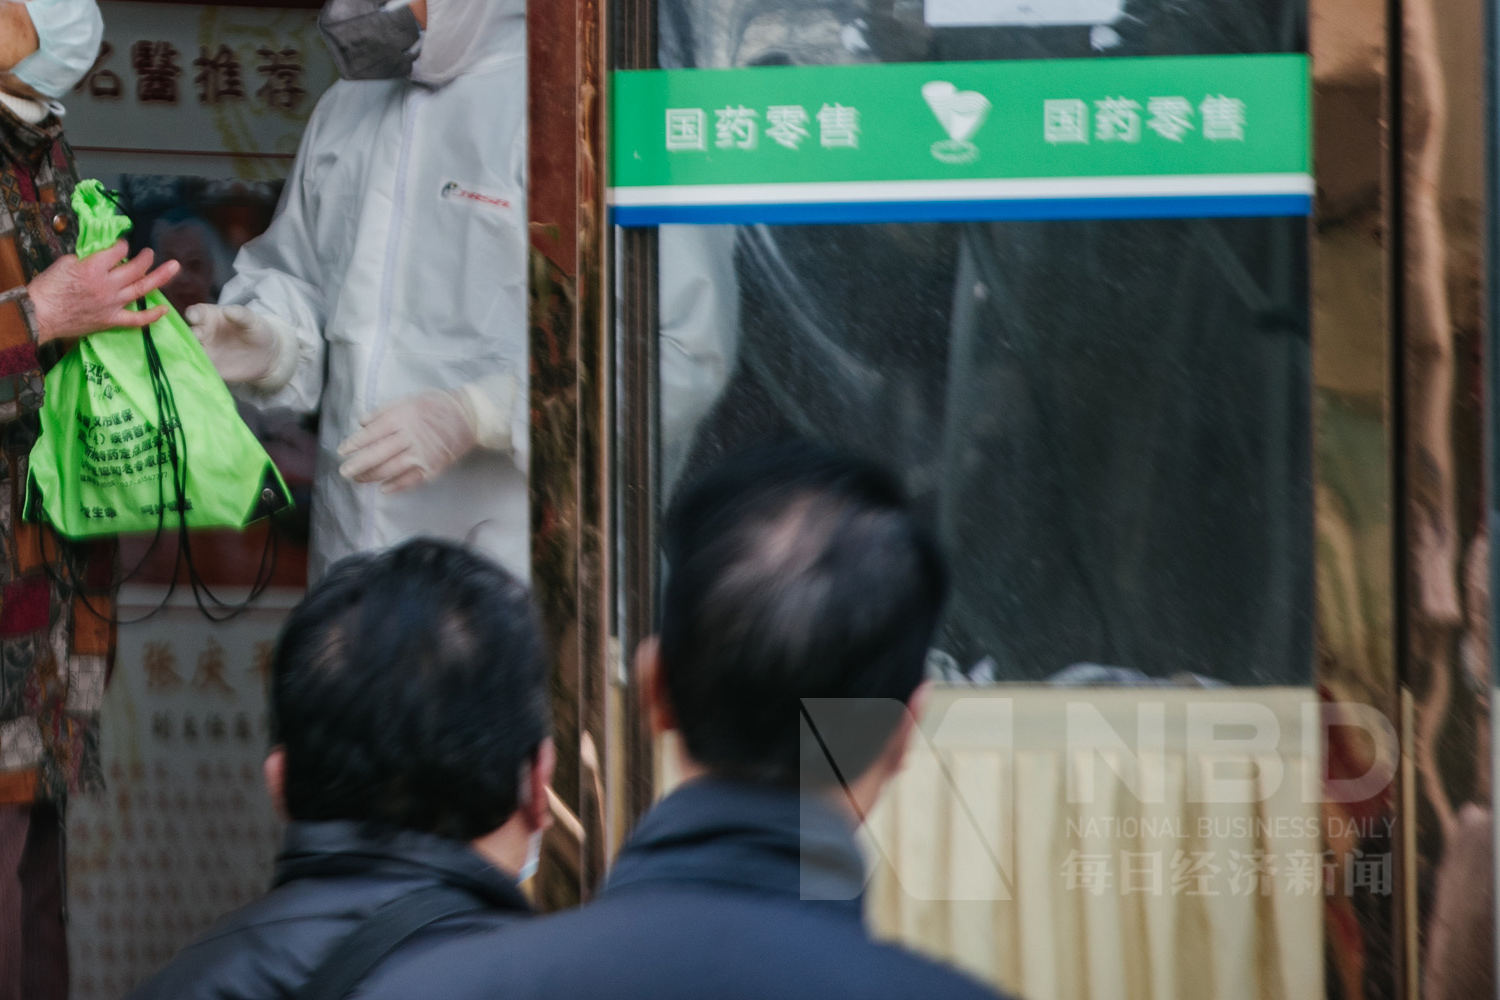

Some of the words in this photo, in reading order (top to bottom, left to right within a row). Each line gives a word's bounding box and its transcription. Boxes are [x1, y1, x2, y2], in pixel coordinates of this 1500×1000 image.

[665, 102, 862, 153] 国药零售
[1043, 93, 1248, 145] 国药零售
